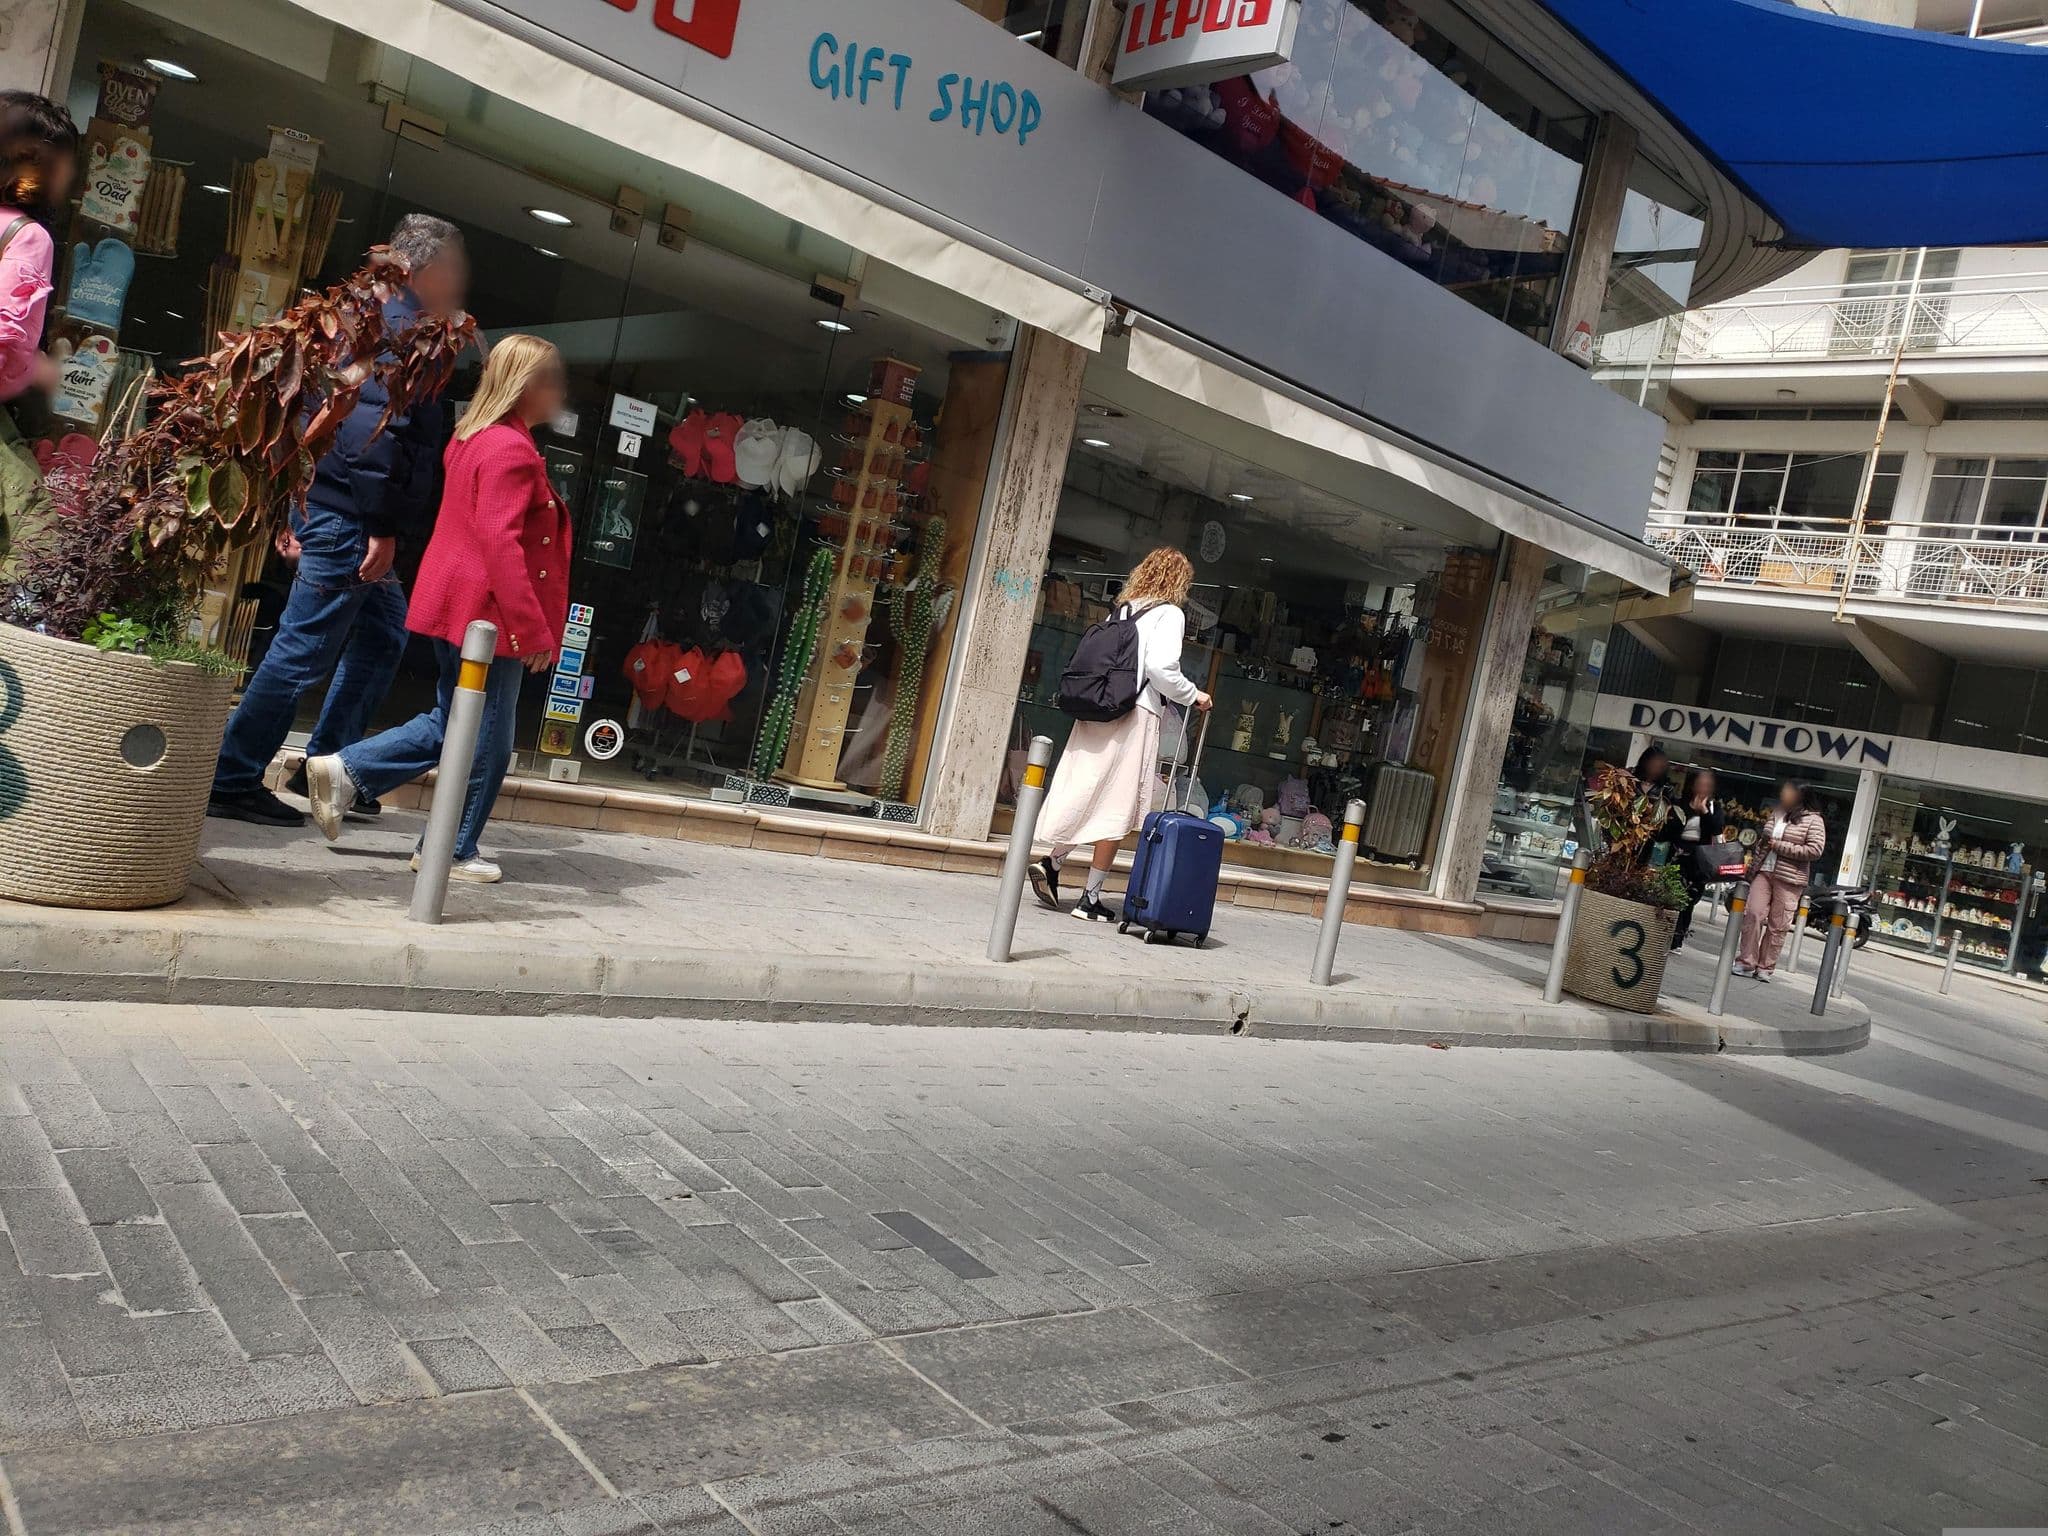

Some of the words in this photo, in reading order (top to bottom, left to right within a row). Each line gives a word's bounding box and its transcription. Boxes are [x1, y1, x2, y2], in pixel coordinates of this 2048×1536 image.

[106, 80, 149, 106] OVEN
[809, 32, 913, 111] GIFT
[929, 73, 1042, 146] SHOP
[95, 181, 131, 203] Dad
[72, 289, 120, 307] Grandpa
[64, 370, 96, 387] Aunt
[552, 703, 577, 715] VISA
[1629, 702, 1892, 767] DOWNTOWN
[1609, 920, 1646, 990] 3
